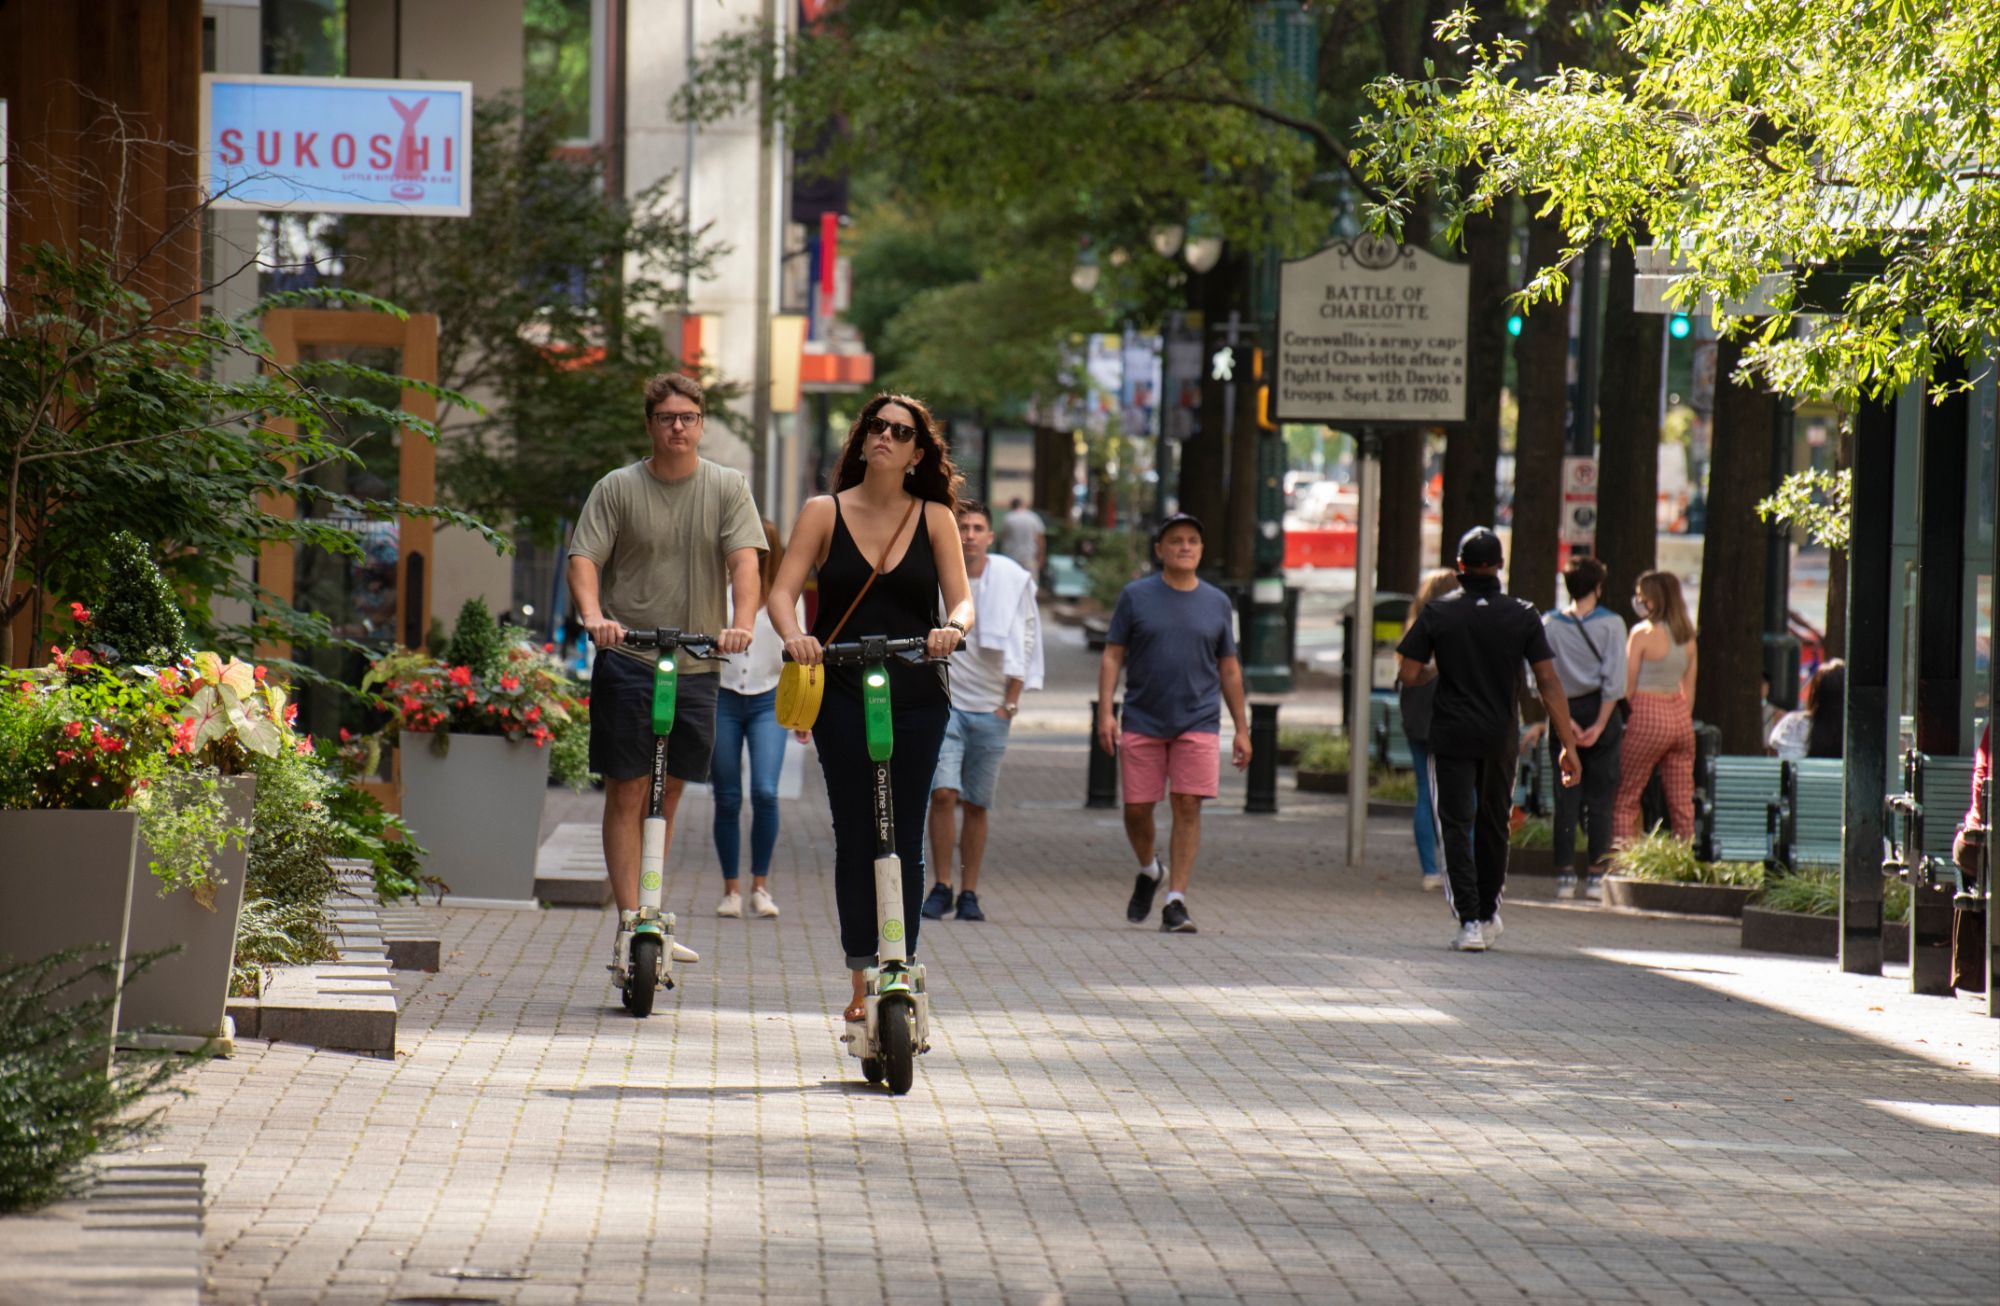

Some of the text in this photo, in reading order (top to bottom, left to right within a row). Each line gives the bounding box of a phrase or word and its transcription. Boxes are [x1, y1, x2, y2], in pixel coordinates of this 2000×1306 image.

[219, 128, 453, 172] SUKOSHI
[1325, 285, 1425, 301] BATTLE OF
[1319, 303, 1429, 320] CHARLOTTE
[1284, 331, 1376, 348] Cornwallis's
[1380, 336, 1423, 350] army
[1284, 350, 1463, 367] tured Charlotte after a
[1283, 368, 1463, 385] fight here with Davie's
[868, 696, 887, 704] Lime
[656, 740, 665, 754] On
[654, 754, 664, 776] Lime
[877, 769, 887, 784] On
[878, 785, 888, 809] Lime
[879, 817, 889, 841] Uber
